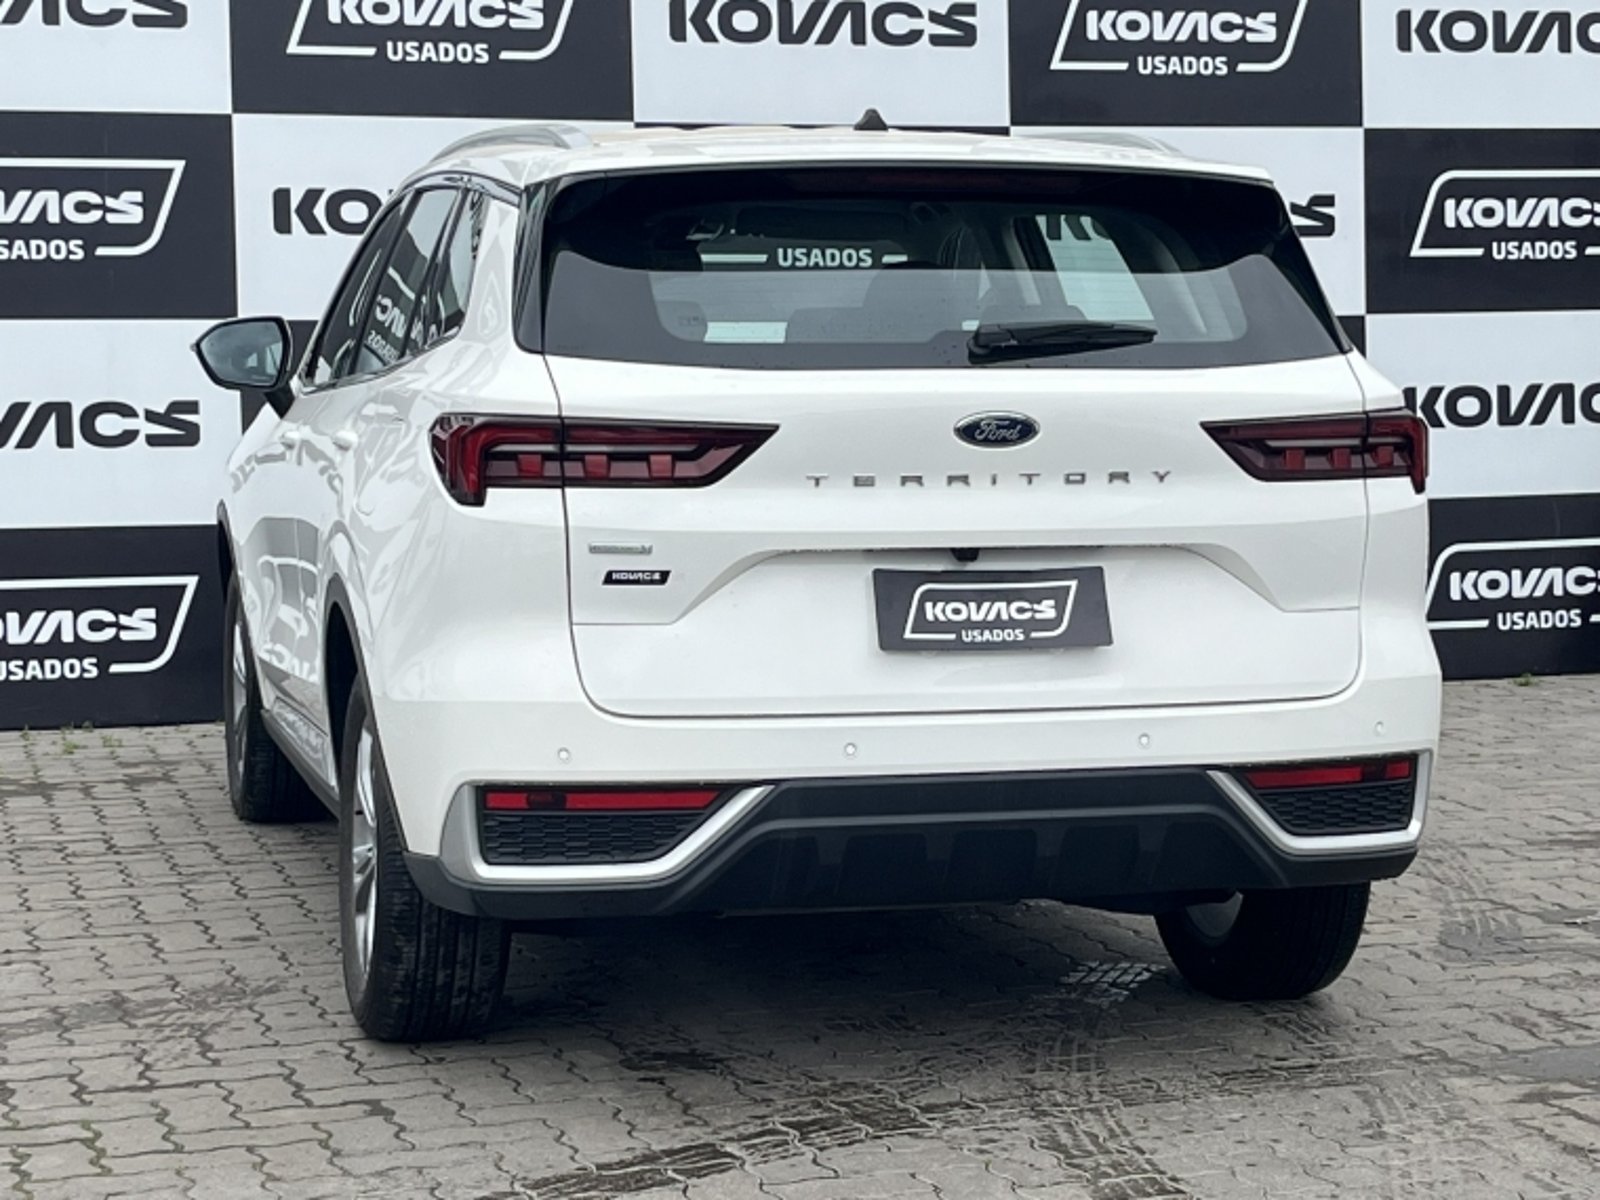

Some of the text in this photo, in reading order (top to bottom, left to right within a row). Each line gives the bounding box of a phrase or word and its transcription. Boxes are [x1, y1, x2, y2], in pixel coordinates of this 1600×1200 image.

[327, 0, 544, 30] KOVACS
[668, 0, 978, 47] KOVACS
[1086, 9, 1277, 43] KOVACS
[386, 41, 490, 64] USADOS
[1137, 55, 1229, 76] USADOS
[1443, 197, 1600, 229] KOVAC
[776, 248, 873, 268] USADOS
[1491, 240, 1578, 261] USADOS
[974, 419, 1022, 440] Ford
[805, 469, 1172, 488] TERRITORY
[1449, 566, 1600, 601] KOVAC
[925, 599, 1057, 622] KOVACS
[1496, 608, 1582, 631] USADOS
[0, 607, 157, 645] VACS
[961, 628, 1025, 643] USADOS
